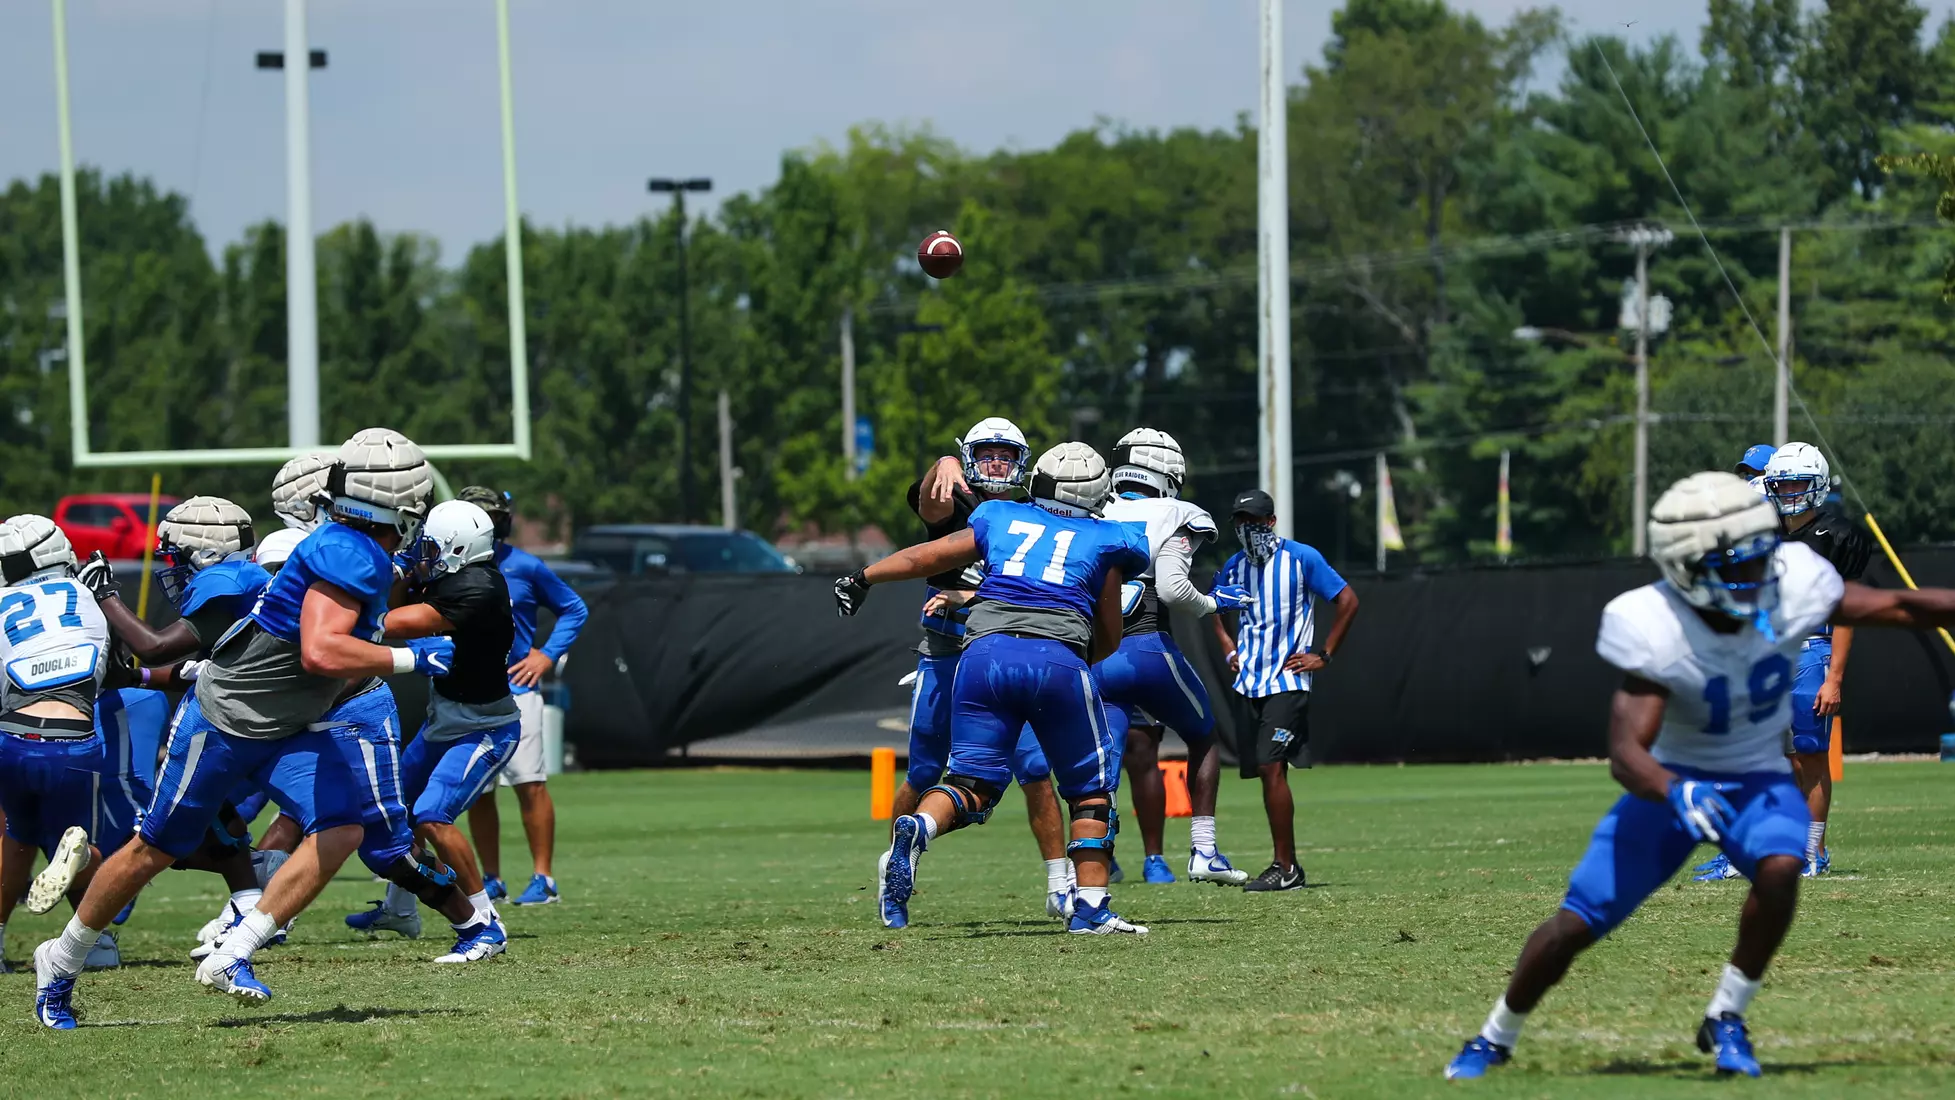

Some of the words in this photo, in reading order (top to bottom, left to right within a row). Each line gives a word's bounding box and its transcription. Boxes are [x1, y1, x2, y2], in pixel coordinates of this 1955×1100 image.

[1125, 471, 1148, 481] RAIDERS
[344, 506, 373, 519] RAIDERS
[1002, 519, 1077, 585] 71
[0, 581, 83, 647] 27
[31, 656, 78, 676] DOUGLAS
[1701, 653, 1792, 735] 19
